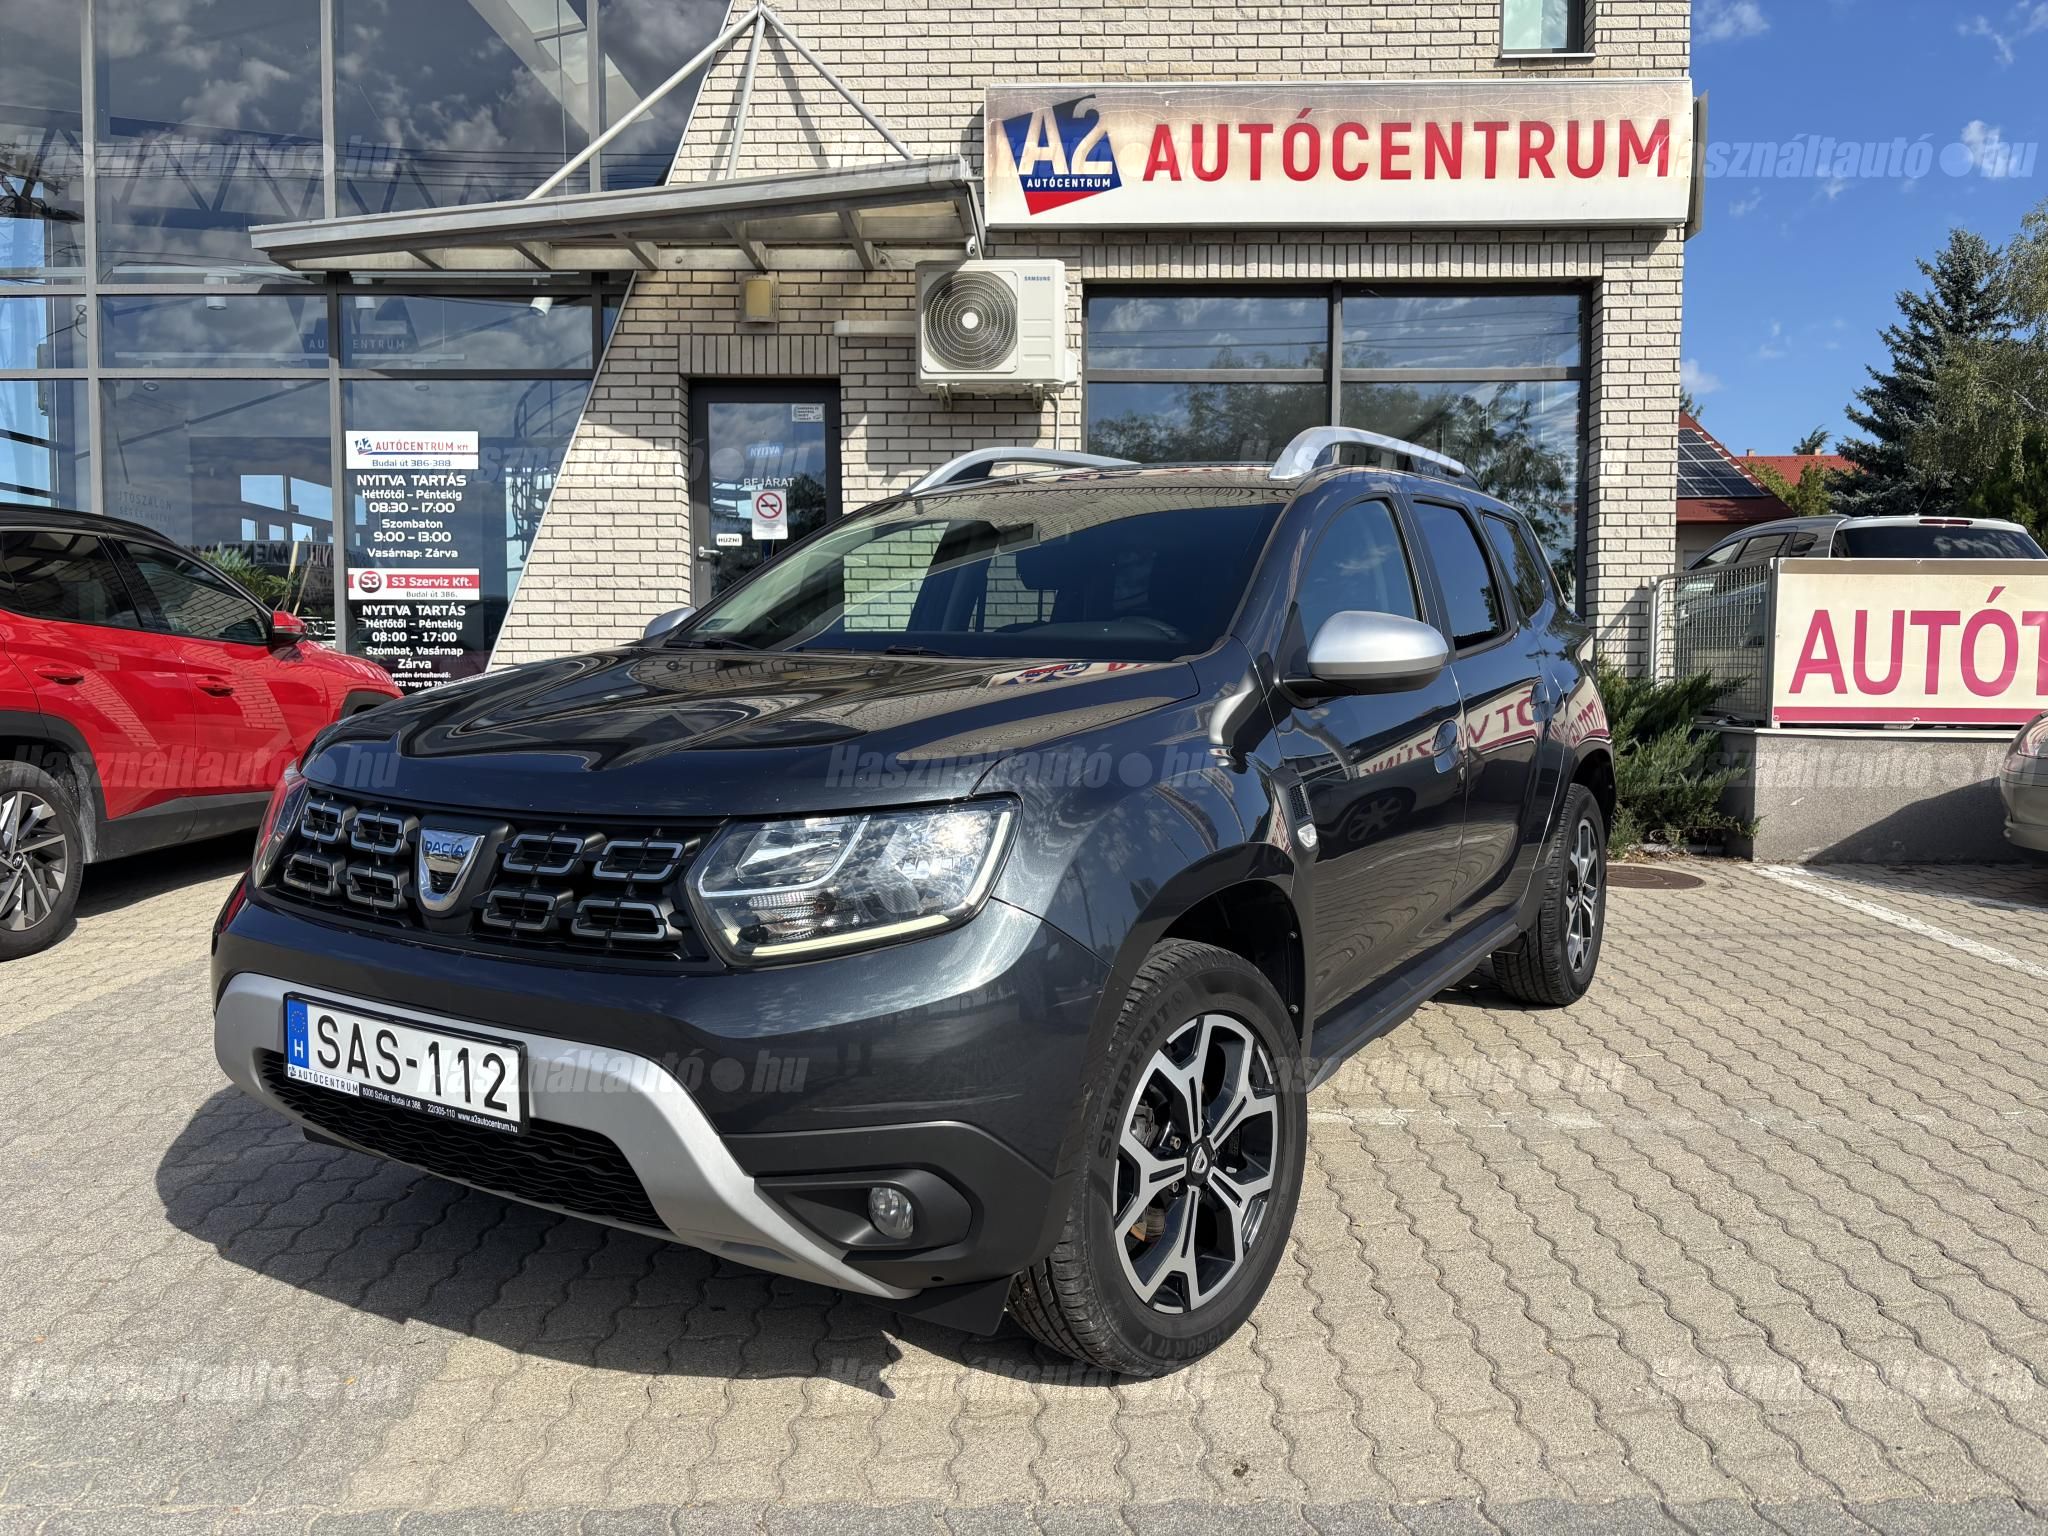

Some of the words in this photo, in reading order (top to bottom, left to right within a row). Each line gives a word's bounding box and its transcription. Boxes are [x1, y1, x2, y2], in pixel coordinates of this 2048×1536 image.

[1018, 95, 1113, 175] A2
[1142, 107, 1670, 182] AUTÓCENTRUM
[1026, 176, 1112, 190] AUTÓCENTRUM
[308, 338, 406, 350] AUENTRUM
[375, 440, 454, 451] AUTÓCENTRUM
[750, 445, 780, 457] NYITVA
[372, 459, 397, 467] Budai
[399, 459, 409, 467] út
[356, 474, 407, 487] NYITVA
[411, 472, 467, 487] TARTÁS
[743, 476, 795, 488] BEJÁRAT
[362, 489, 405, 499] Hétfőtől
[416, 489, 463, 501] Péntekig
[369, 502, 409, 513] 08:30
[421, 502, 456, 513] 17:00
[381, 519, 443, 529] Szombaton
[373, 531, 405, 543] 9:00
[418, 531, 452, 543] 13:00
[367, 548, 422, 560] Vasárnap:
[425, 548, 459, 558] Zárva
[361, 573, 380, 588] S3
[391, 576, 406, 587] S3
[409, 576, 450, 587] Szerviz
[452, 576, 473, 587] Kft.
[362, 605, 411, 616] NYITVA
[416, 602, 466, 616] TARTÁS
[366, 619, 407, 629] Hétfőtől
[418, 619, 463, 630] Péntekig
[372, 632, 407, 642] 08:00
[422, 632, 457, 642] 17:00
[366, 646, 414, 657] Szombat,
[416, 646, 464, 657] Vasárnap
[397, 657, 432, 669] Zárva
[424, 841, 465, 856] DACIA
[294, 1039, 304, 1058] H
[317, 1014, 508, 1112] SAS-112
[297, 1068, 359, 1095] AUTÓCENTRUM
[1099, 1003, 1172, 1160] SEMPERIT
[458, 1112, 518, 1133] www.a2autocentrum.hu
